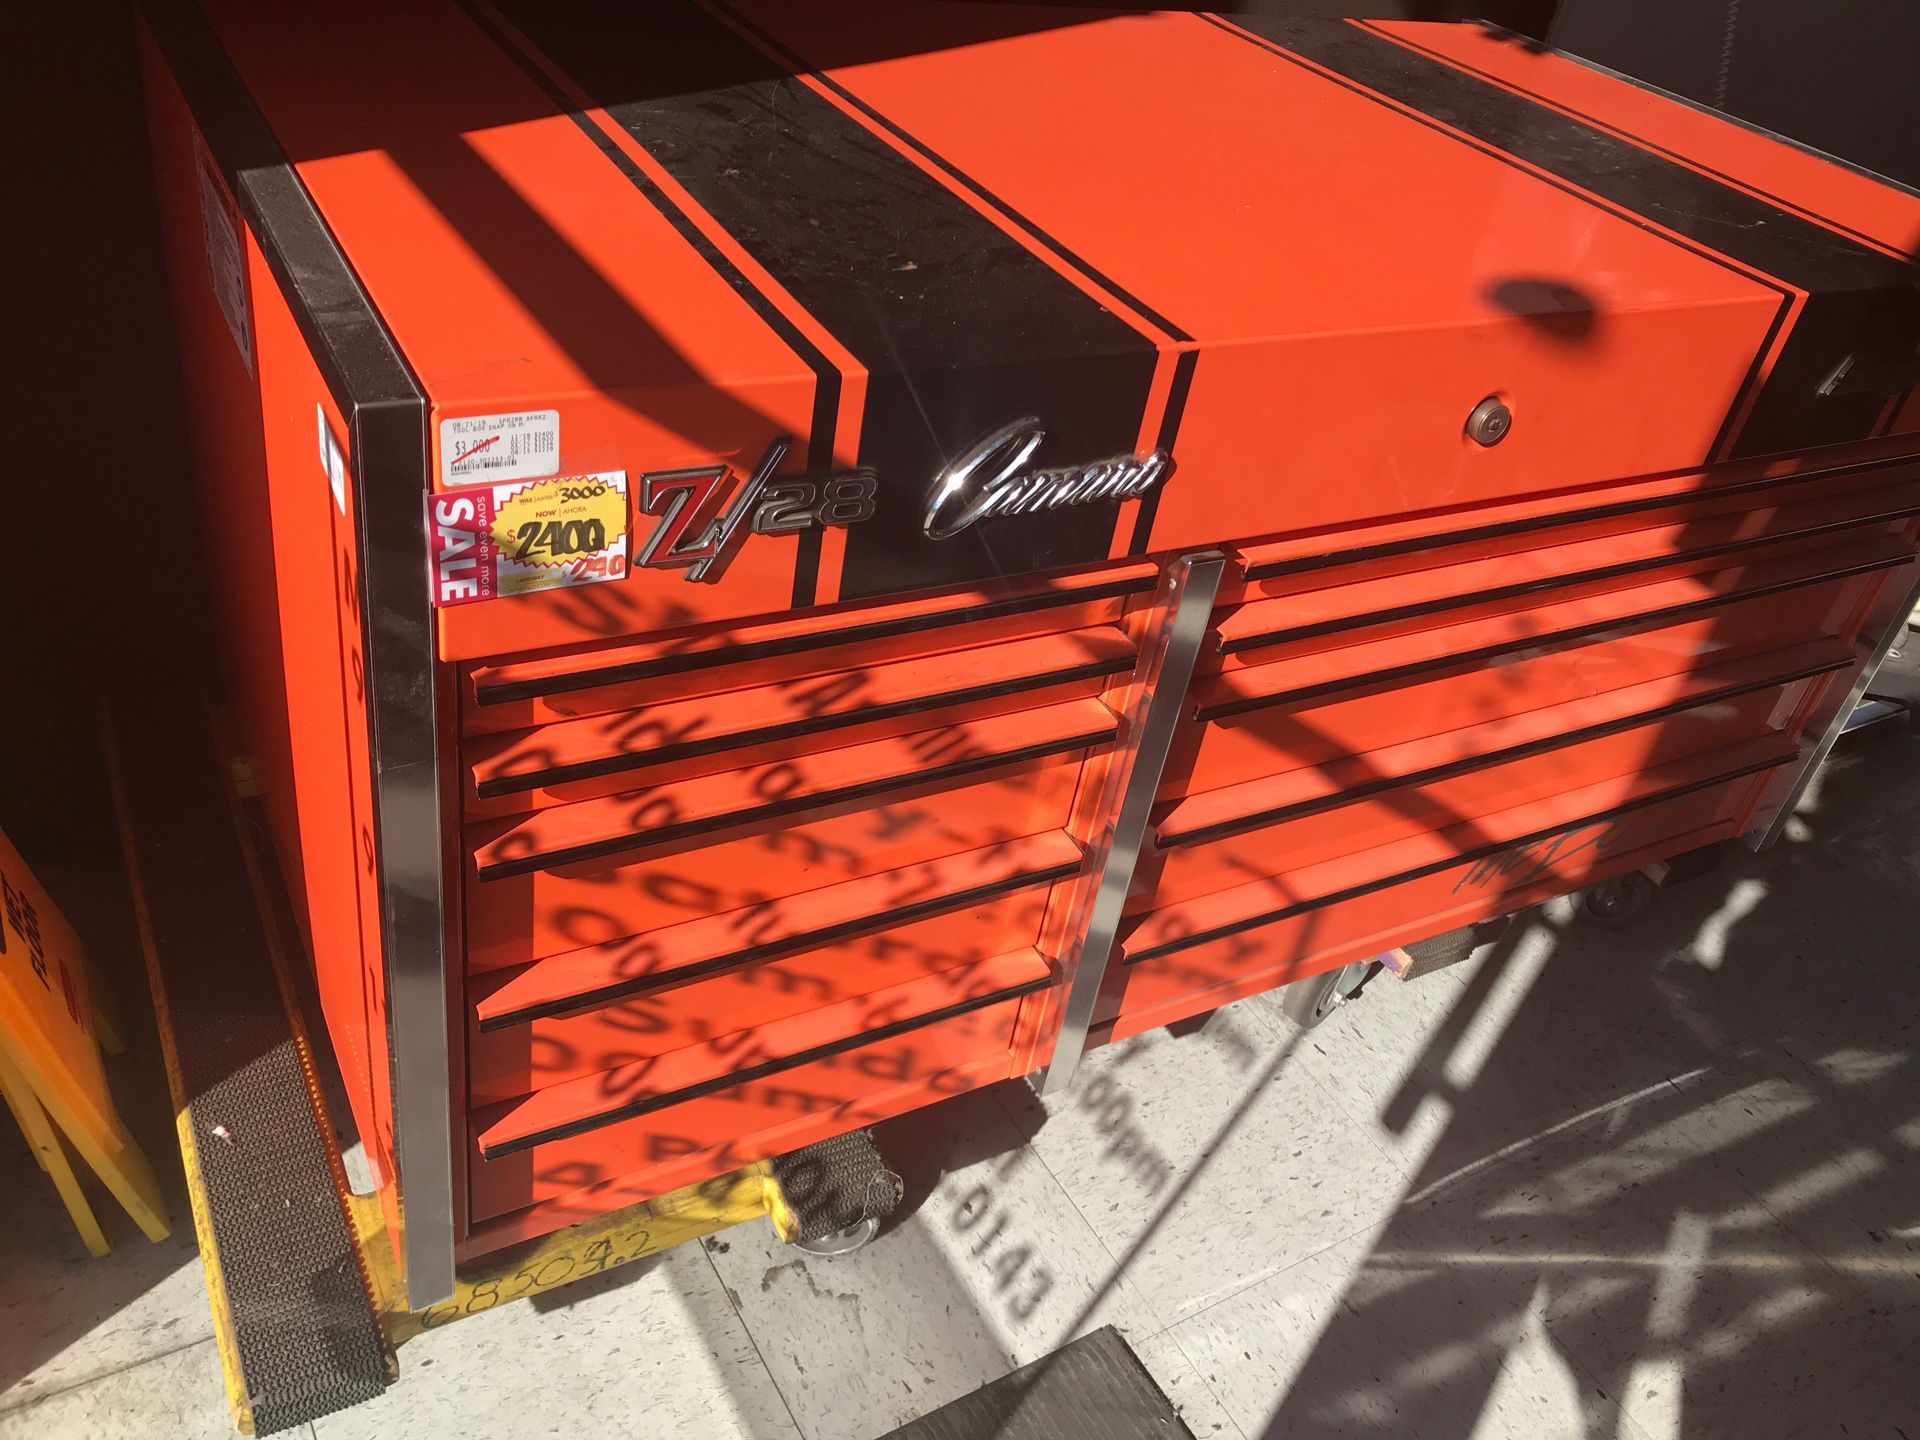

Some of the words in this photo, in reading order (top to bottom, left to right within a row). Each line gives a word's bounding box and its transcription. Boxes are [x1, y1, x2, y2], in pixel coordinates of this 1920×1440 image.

[455, 438, 490, 455] $3000
[924, 416, 1169, 540] Camaro
[477, 496, 487, 527] save
[535, 510, 557, 518] NOW
[562, 506, 587, 515] AHORA
[435, 498, 478, 602] SALE
[480, 531, 489, 561] even
[481, 566, 490, 596] more
